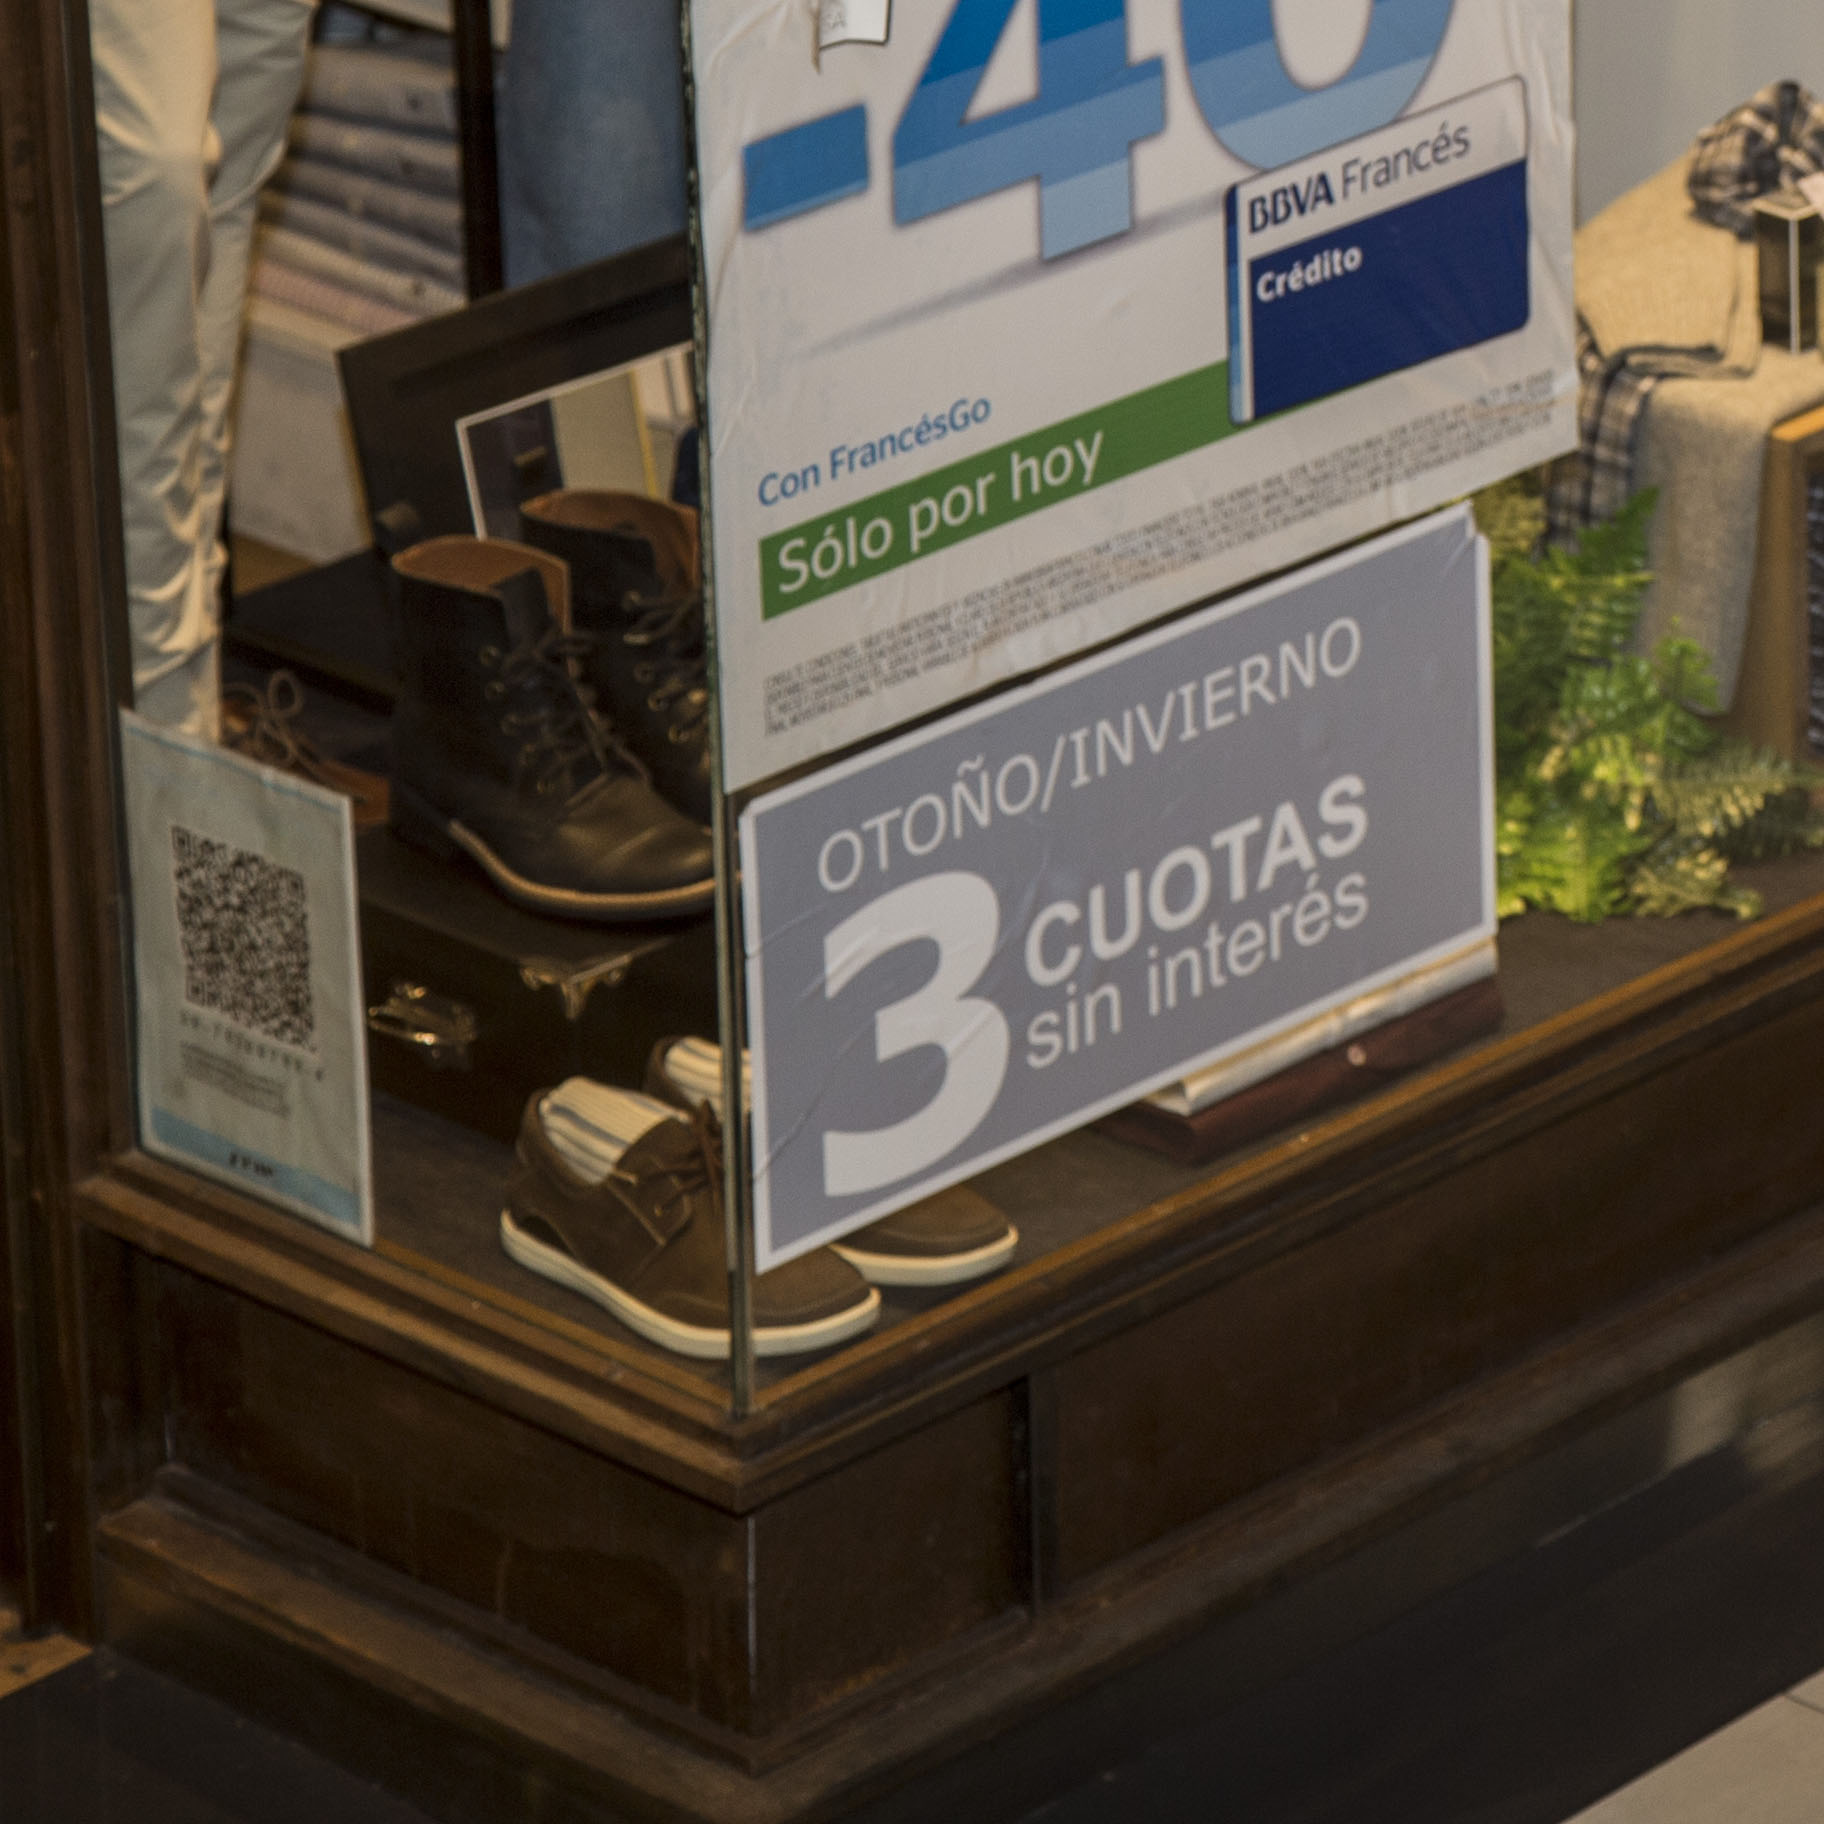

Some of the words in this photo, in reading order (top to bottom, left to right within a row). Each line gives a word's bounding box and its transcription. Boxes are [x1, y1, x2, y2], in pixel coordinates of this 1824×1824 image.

[1248, 172, 1335, 234] BBVA
[1341, 120, 1471, 200] Francés
[1256, 246, 1363, 302] Crédito
[758, 462, 821, 507] Con
[829, 396, 992, 480] FrancésGo
[778, 517, 893, 594] Sólo
[909, 472, 997, 554] por
[1011, 430, 1104, 503] hoy
[816, 616, 1362, 893] OTOÑO/INVIERNO
[824, 870, 1011, 1198] 3
[1025, 774, 1369, 987] CUOTAS
[1026, 980, 1123, 1070] sin
[1148, 869, 1369, 1016] interés
